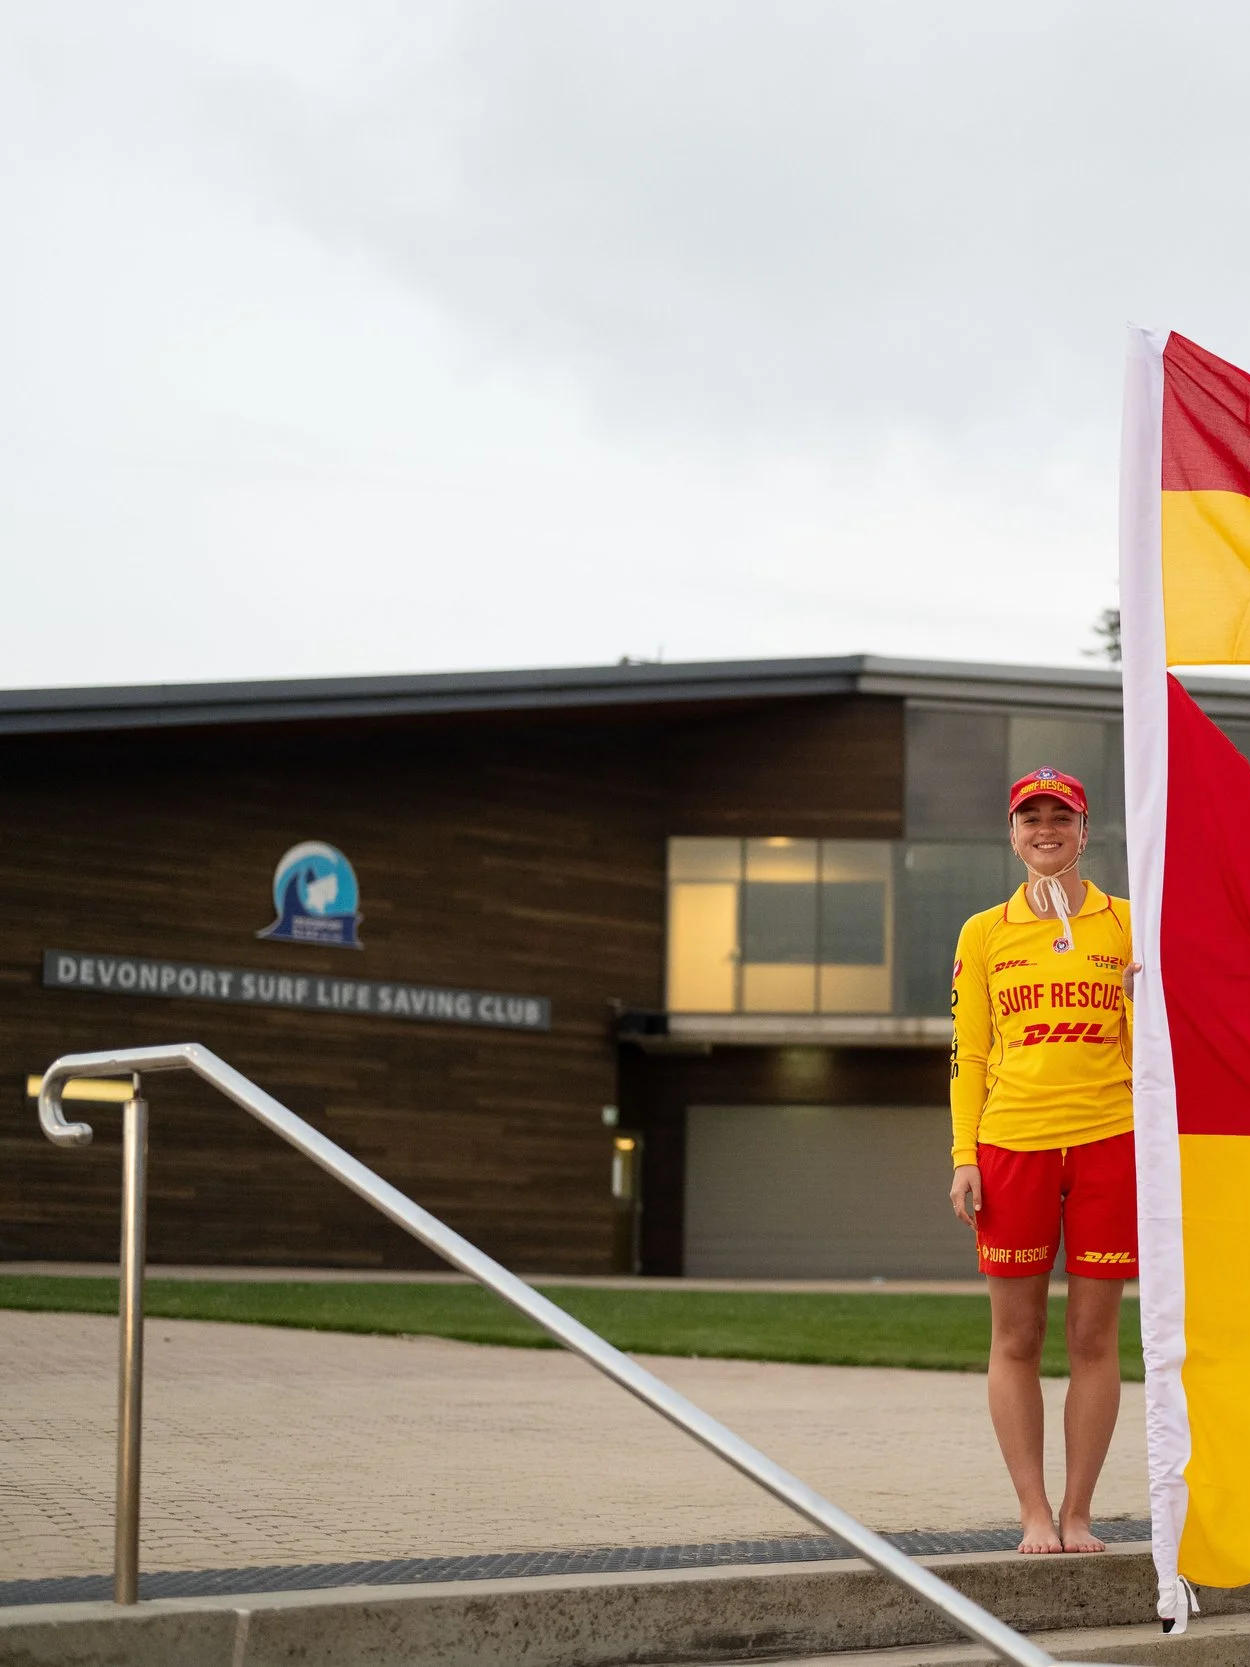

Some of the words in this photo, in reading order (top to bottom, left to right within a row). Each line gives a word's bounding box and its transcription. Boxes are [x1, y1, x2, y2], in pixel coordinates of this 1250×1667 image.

[1020, 780, 1039, 795] SURF
[1040, 780, 1072, 796] RESCUE
[994, 959, 1029, 973] DHL
[1095, 962, 1118, 970] UTE
[58, 956, 232, 998] DEVONPORT
[242, 974, 308, 1005] SURF
[317, 979, 371, 1009] LIFE
[378, 986, 472, 1019] SAVING
[478, 997, 540, 1024] CLUB
[998, 983, 1044, 1017] SURF
[1050, 981, 1122, 1012] RESCUE
[1022, 1022, 1105, 1046] DHL
[989, 1247, 1012, 1264] SURF
[1014, 1245, 1049, 1264] RESCUE
[1083, 1250, 1131, 1264] DHL
